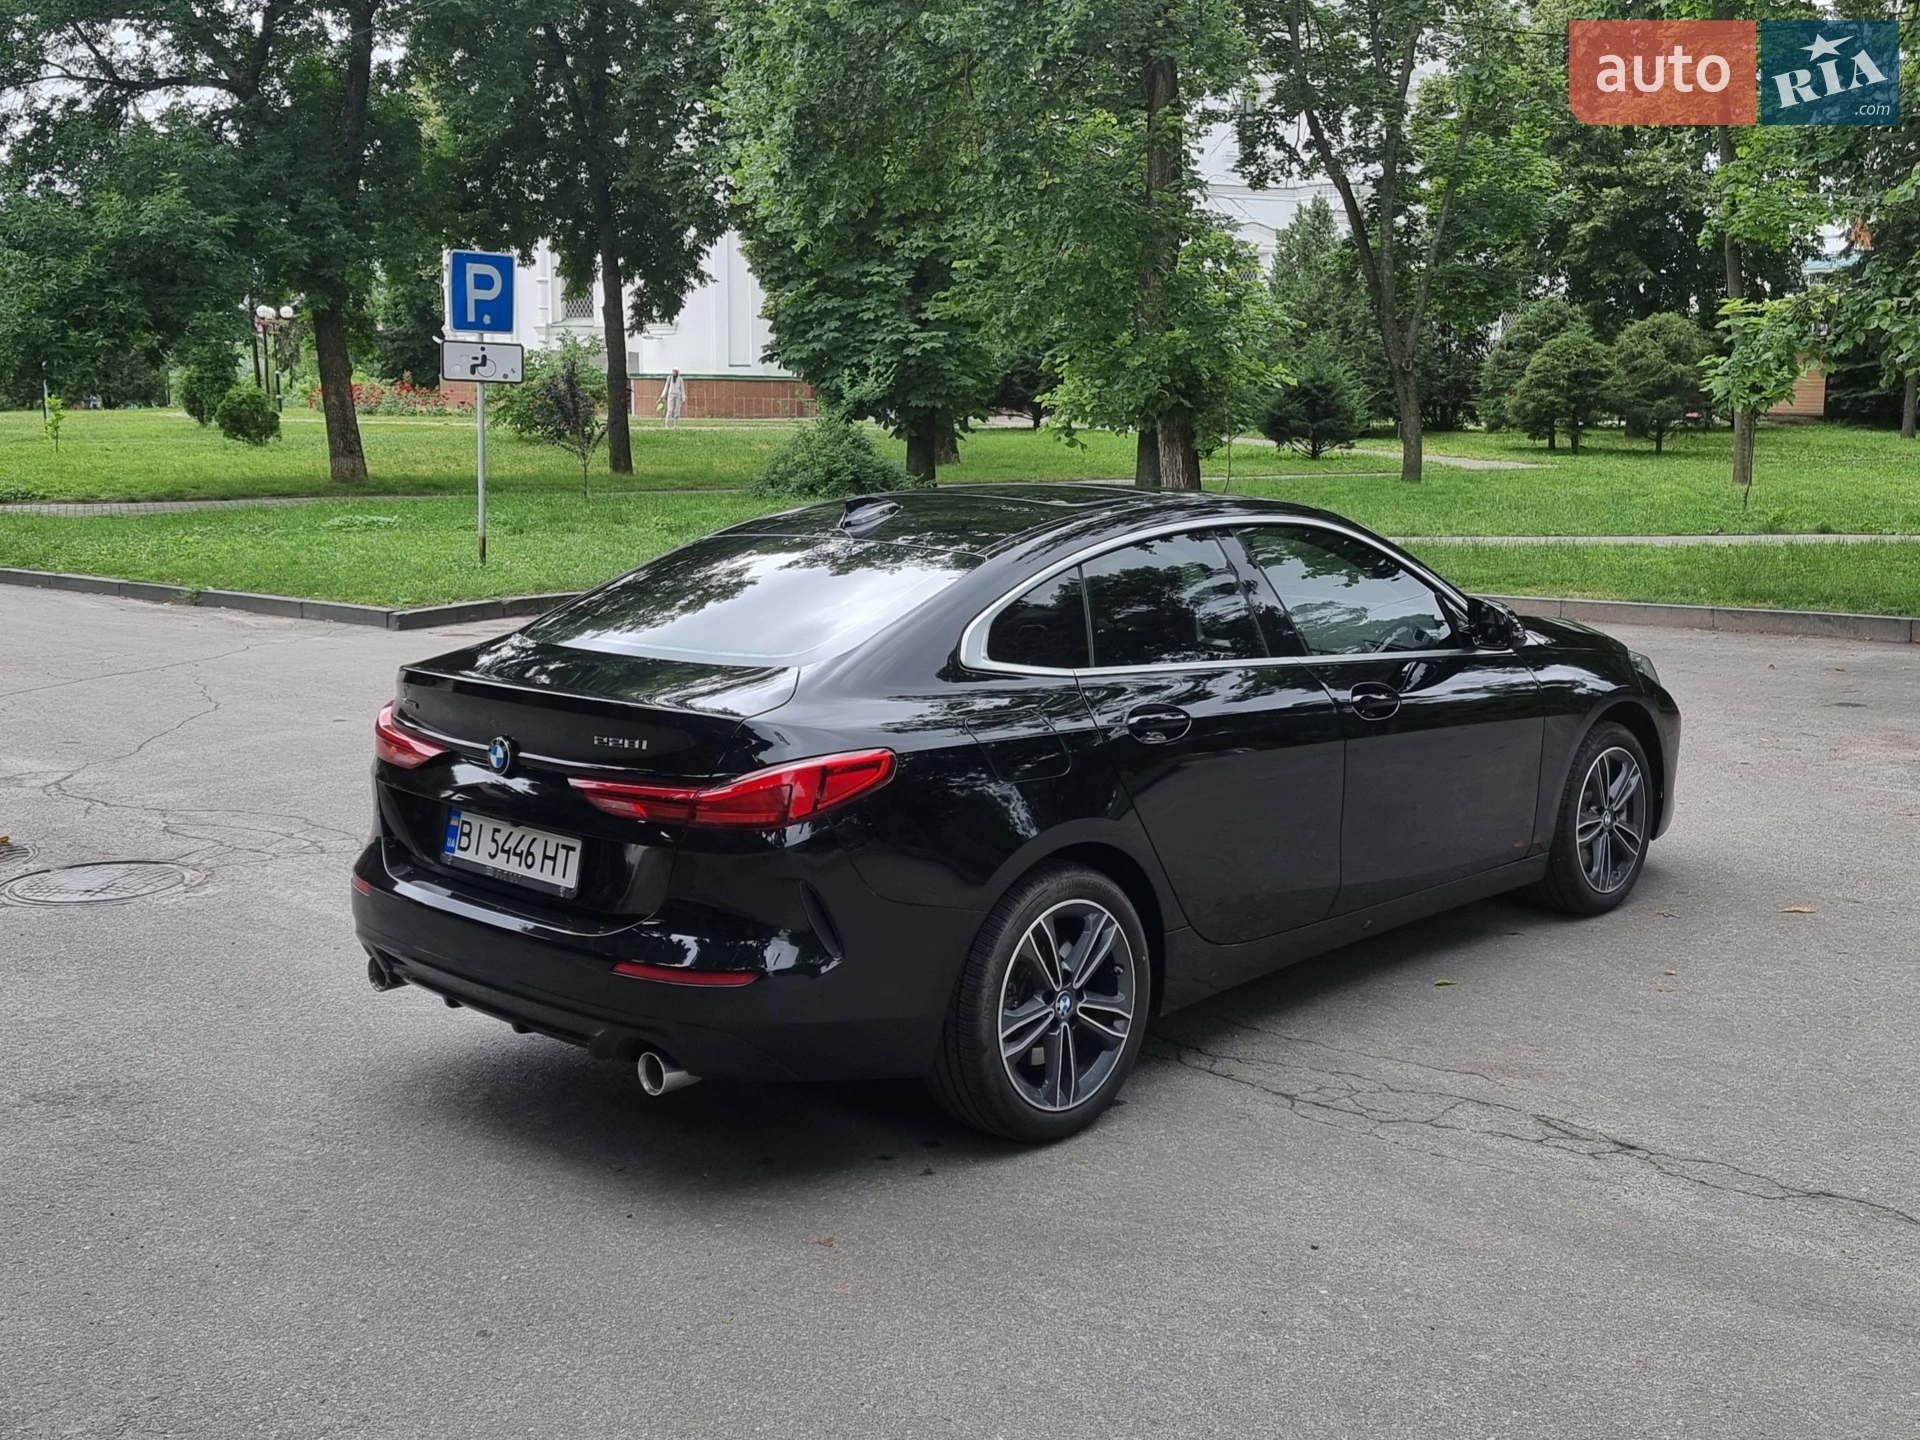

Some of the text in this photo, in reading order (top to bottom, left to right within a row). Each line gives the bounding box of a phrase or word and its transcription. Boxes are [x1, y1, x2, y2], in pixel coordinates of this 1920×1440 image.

[466, 262, 502, 322] P
[446, 837, 456, 848] UA
[457, 819, 577, 879] BI 5446 HT
